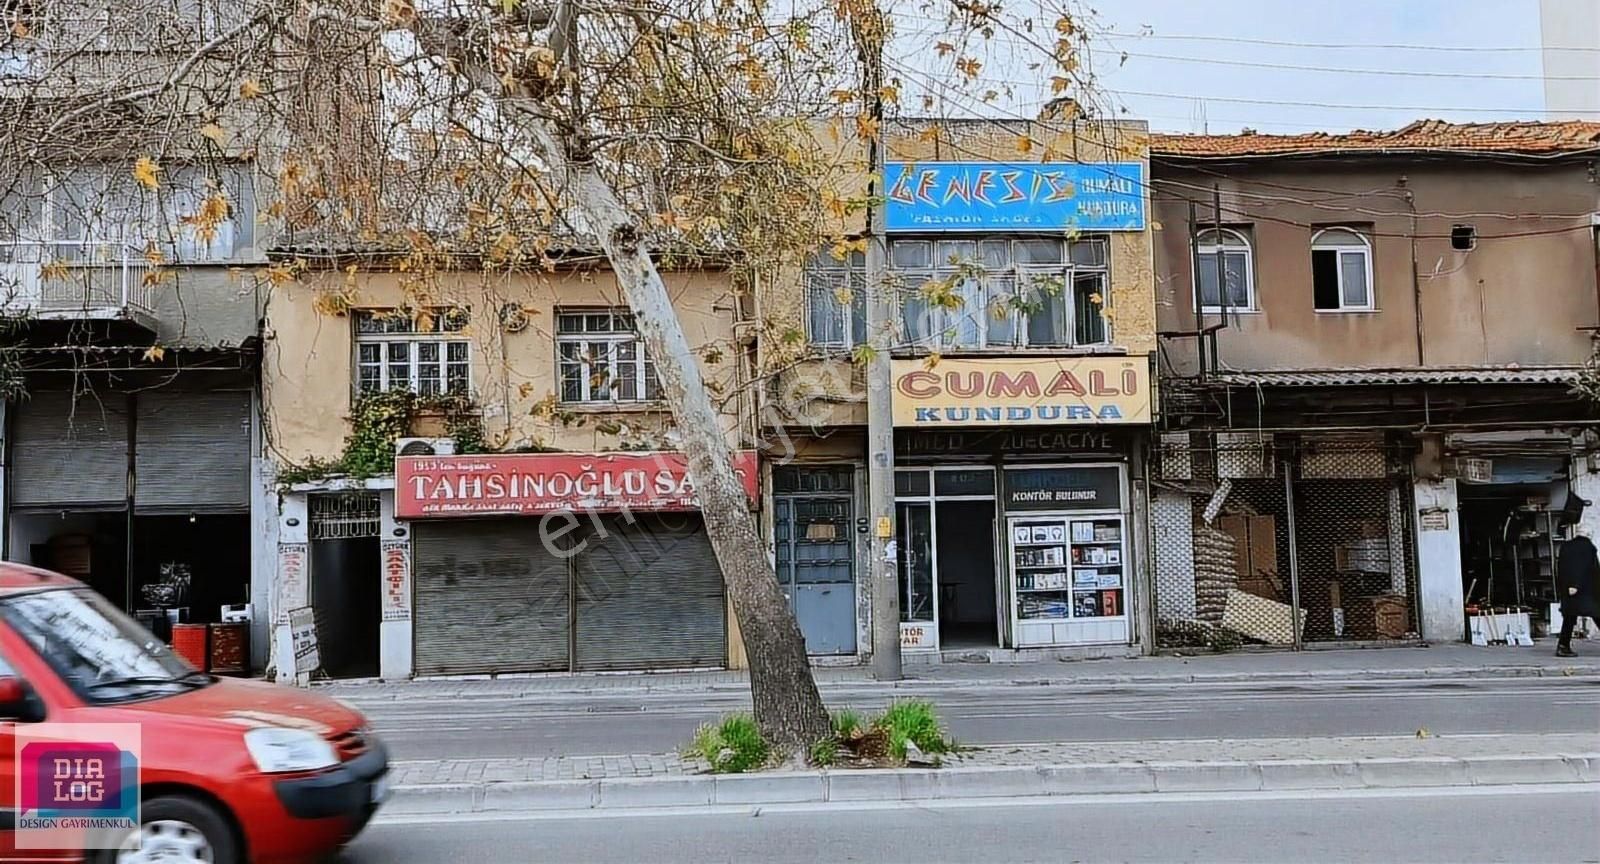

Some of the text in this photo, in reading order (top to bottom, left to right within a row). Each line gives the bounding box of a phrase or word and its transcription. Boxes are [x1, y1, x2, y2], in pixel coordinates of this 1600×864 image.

[888, 167, 1074, 208] GENESIS
[914, 404, 1123, 422] KUNDURA
[408, 464, 646, 499] TAHSİNOĞLU
[1012, 489, 1097, 502] KONTÖR BULUNUR
